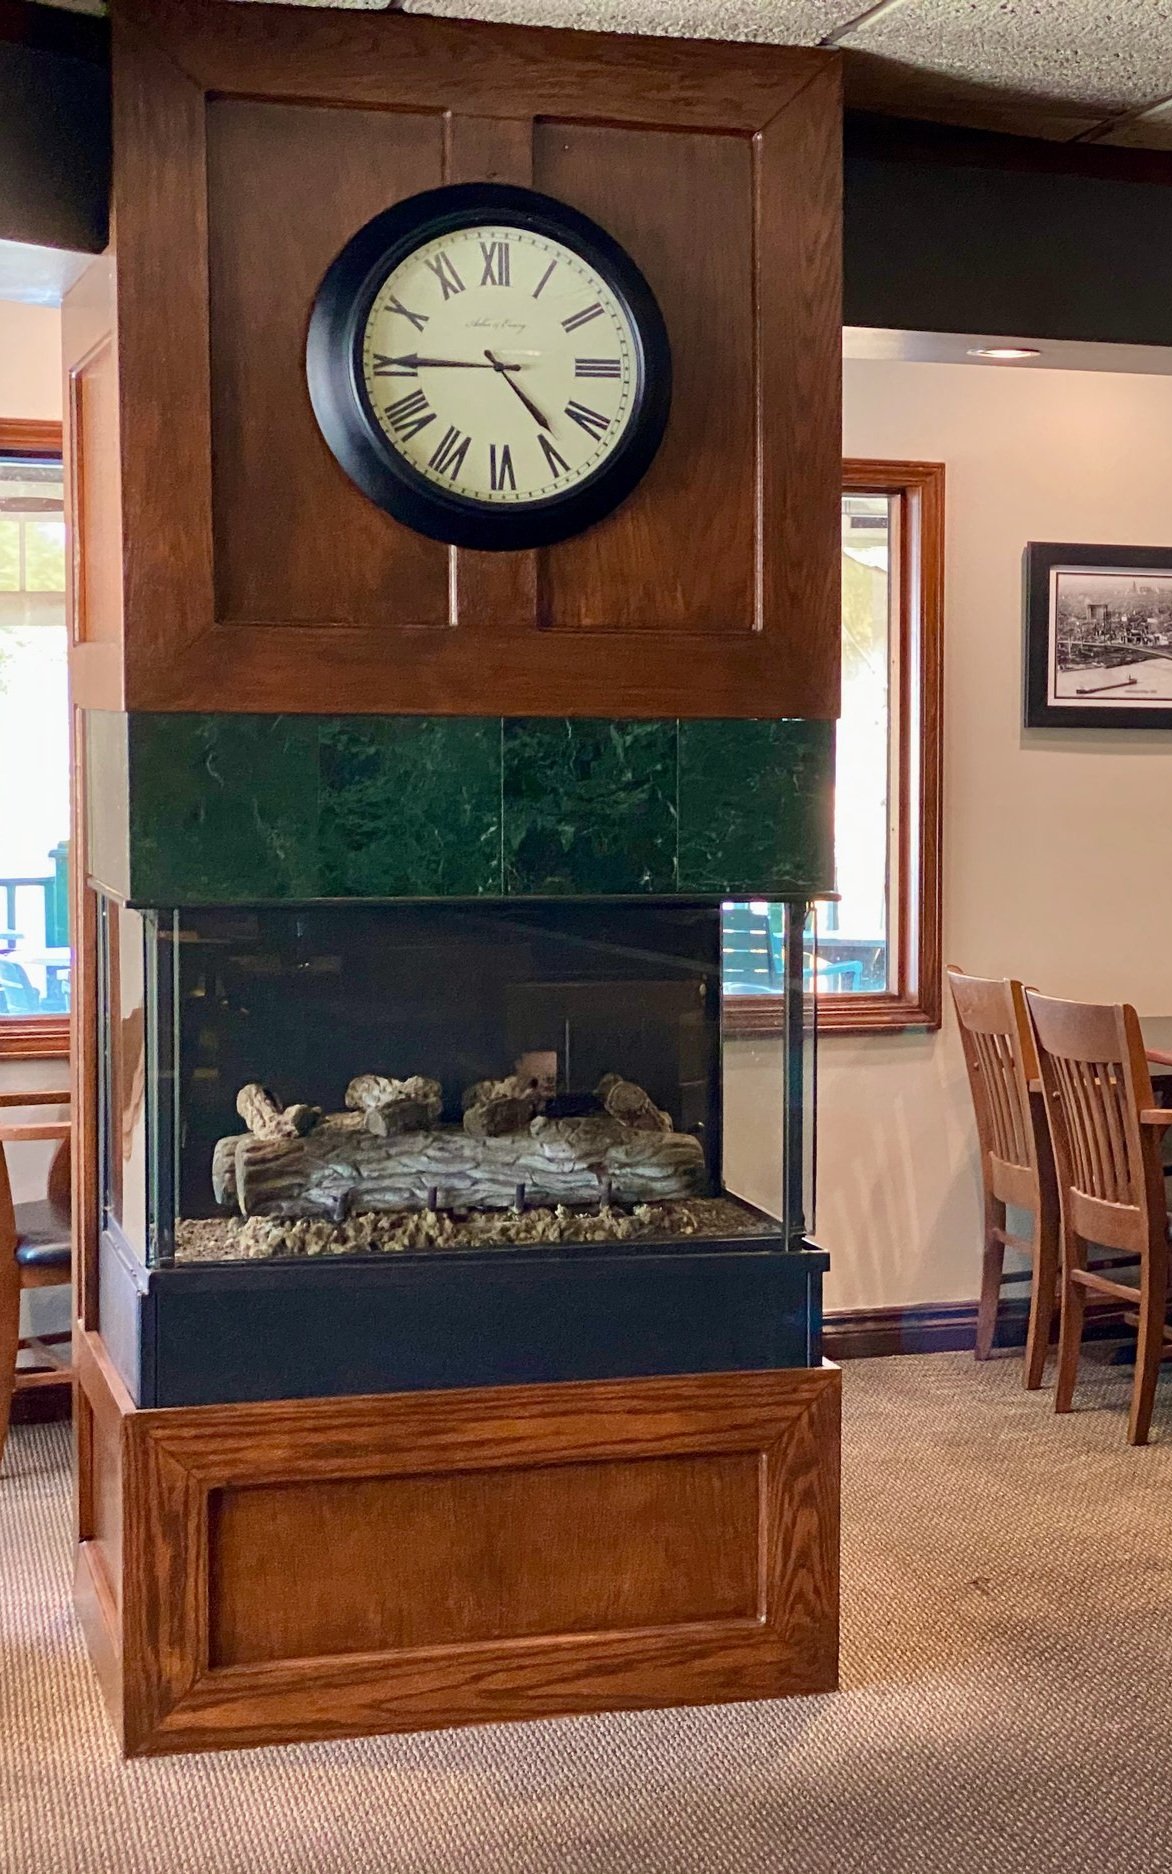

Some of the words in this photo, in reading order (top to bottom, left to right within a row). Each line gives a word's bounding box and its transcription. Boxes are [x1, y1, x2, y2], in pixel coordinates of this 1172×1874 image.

[424, 251, 466, 301] XI
[480, 242, 510, 287] XII
[532, 259, 558, 299] I
[384, 295, 430, 333] X
[560, 302, 605, 333] II
[575, 358, 621, 378] III
[384, 389, 438, 443] VIII
[564, 400, 611, 441] IV
[428, 425, 472, 481] VII
[490, 444, 517, 491] VI
[536, 433, 572, 478] V
